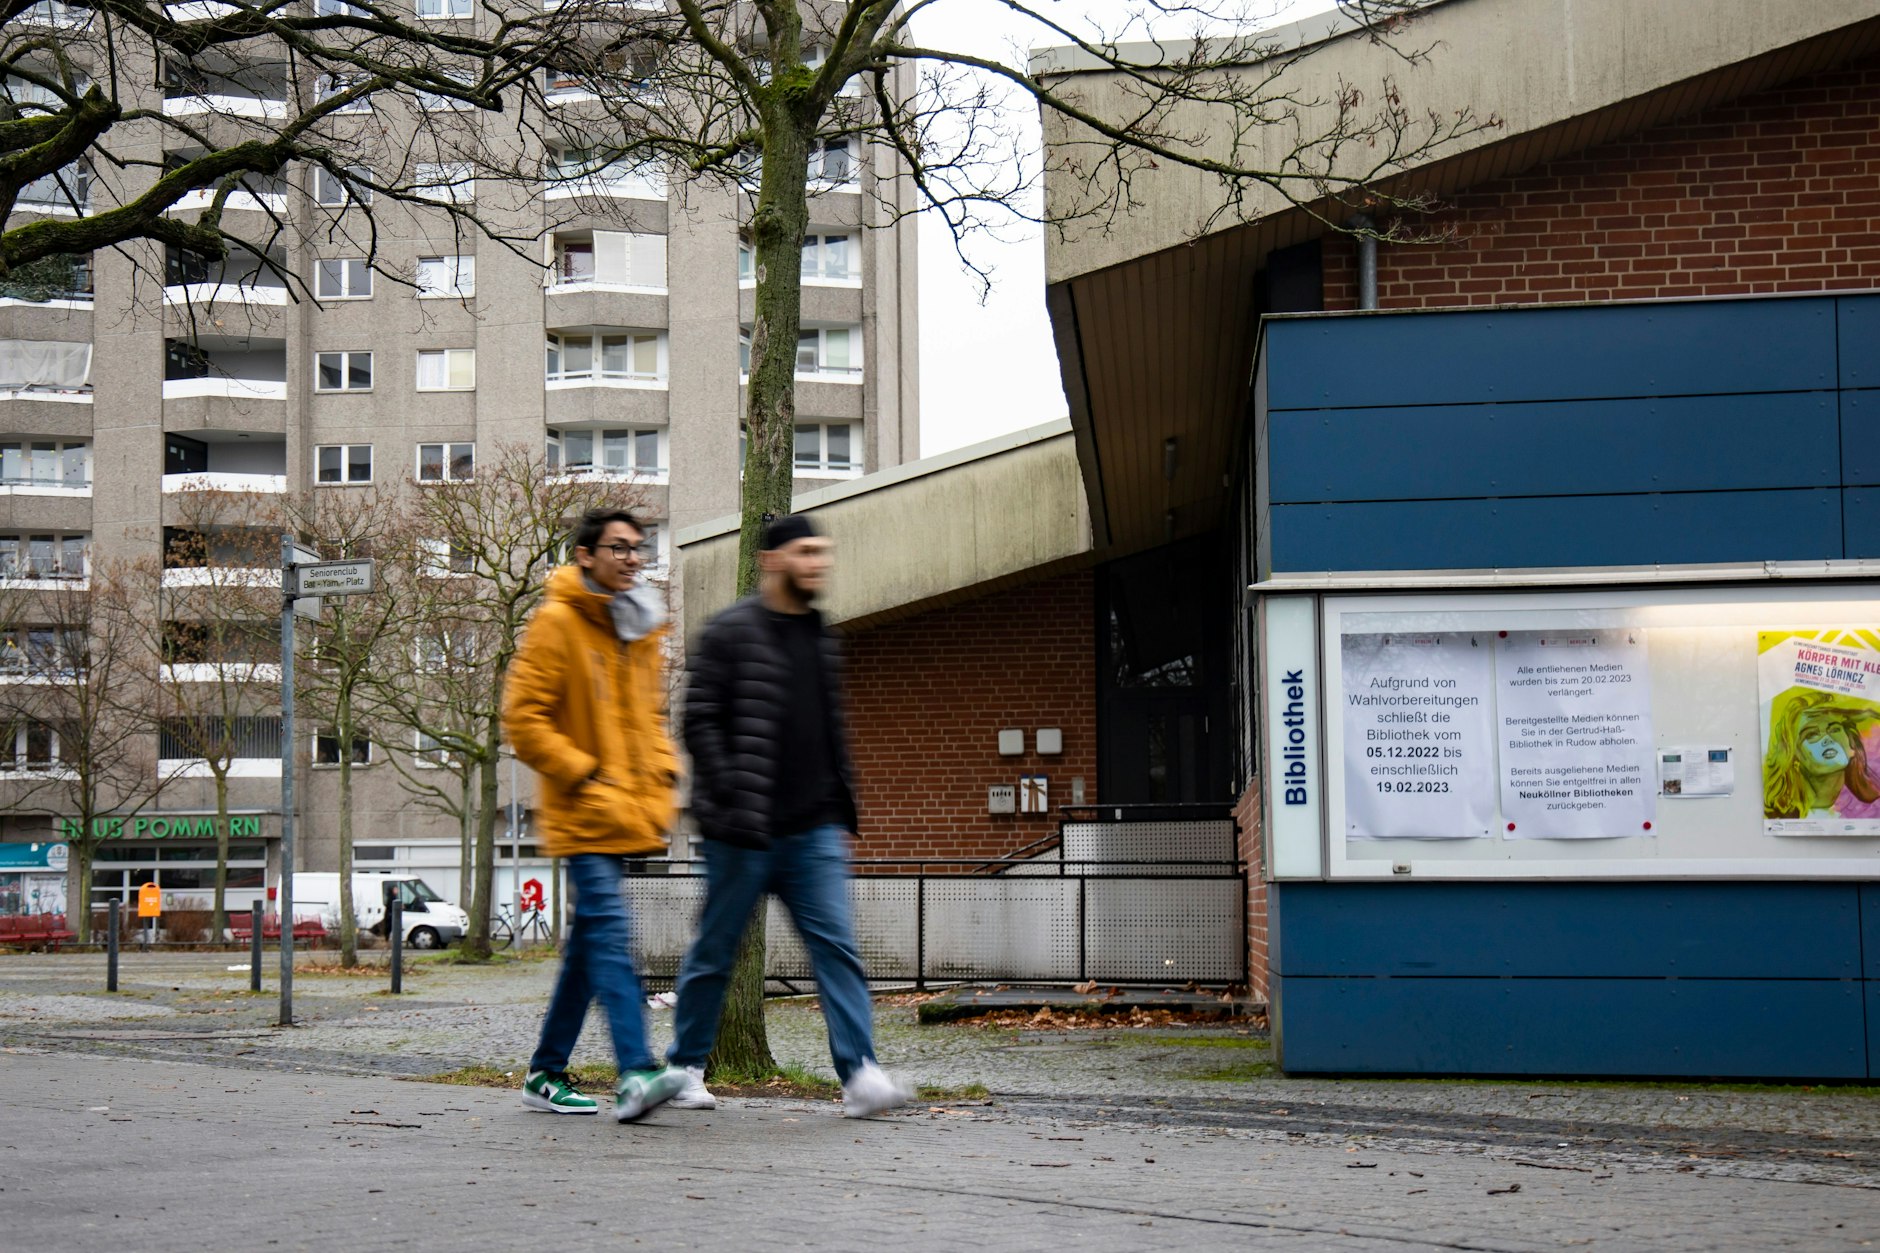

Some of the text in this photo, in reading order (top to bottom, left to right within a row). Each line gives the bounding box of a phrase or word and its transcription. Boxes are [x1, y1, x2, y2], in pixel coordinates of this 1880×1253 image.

[310, 566, 358, 578] Seniorenclub
[346, 577, 365, 586] Platz
[1797, 648, 1838, 666] KÖRPER
[1841, 657, 1862, 670] MIT
[1517, 664, 1623, 674] Alle entliehenen Medien
[1794, 662, 1824, 676] AGNES
[1370, 676, 1456, 691] Aufgrund von
[1509, 678, 1542, 687] wurden
[1544, 677, 1558, 686] bis
[1581, 674, 1632, 684] 20.02.2023
[1548, 688, 1595, 698] verlängert.
[1348, 694, 1478, 708] Wahlvorbereitungen
[1377, 711, 1451, 723] schließt die
[1505, 714, 1640, 726] Bereitgestellte Medien können
[1281, 669, 1307, 805] Bibliothek
[1367, 729, 1462, 740] Bibliothek vom
[1521, 726, 1626, 737] Sie in der Gertrud-Haß-
[1509, 737, 1638, 749] Bibliothek in Rudow abholen.
[1366, 746, 1462, 758] 05.12.2022 bis
[1370, 764, 1458, 776] einschließlich
[1511, 764, 1640, 776] Bereits ausgeliehene Medien
[1376, 781, 1453, 793] 19.02.2023.
[1510, 776, 1642, 788] können Sie entgeltfrei in allen
[1519, 788, 1634, 800] Neuköllner Bibliotheken
[1546, 801, 1607, 812] zurückgeben.
[61, 816, 260, 839] HUS POMMRN
